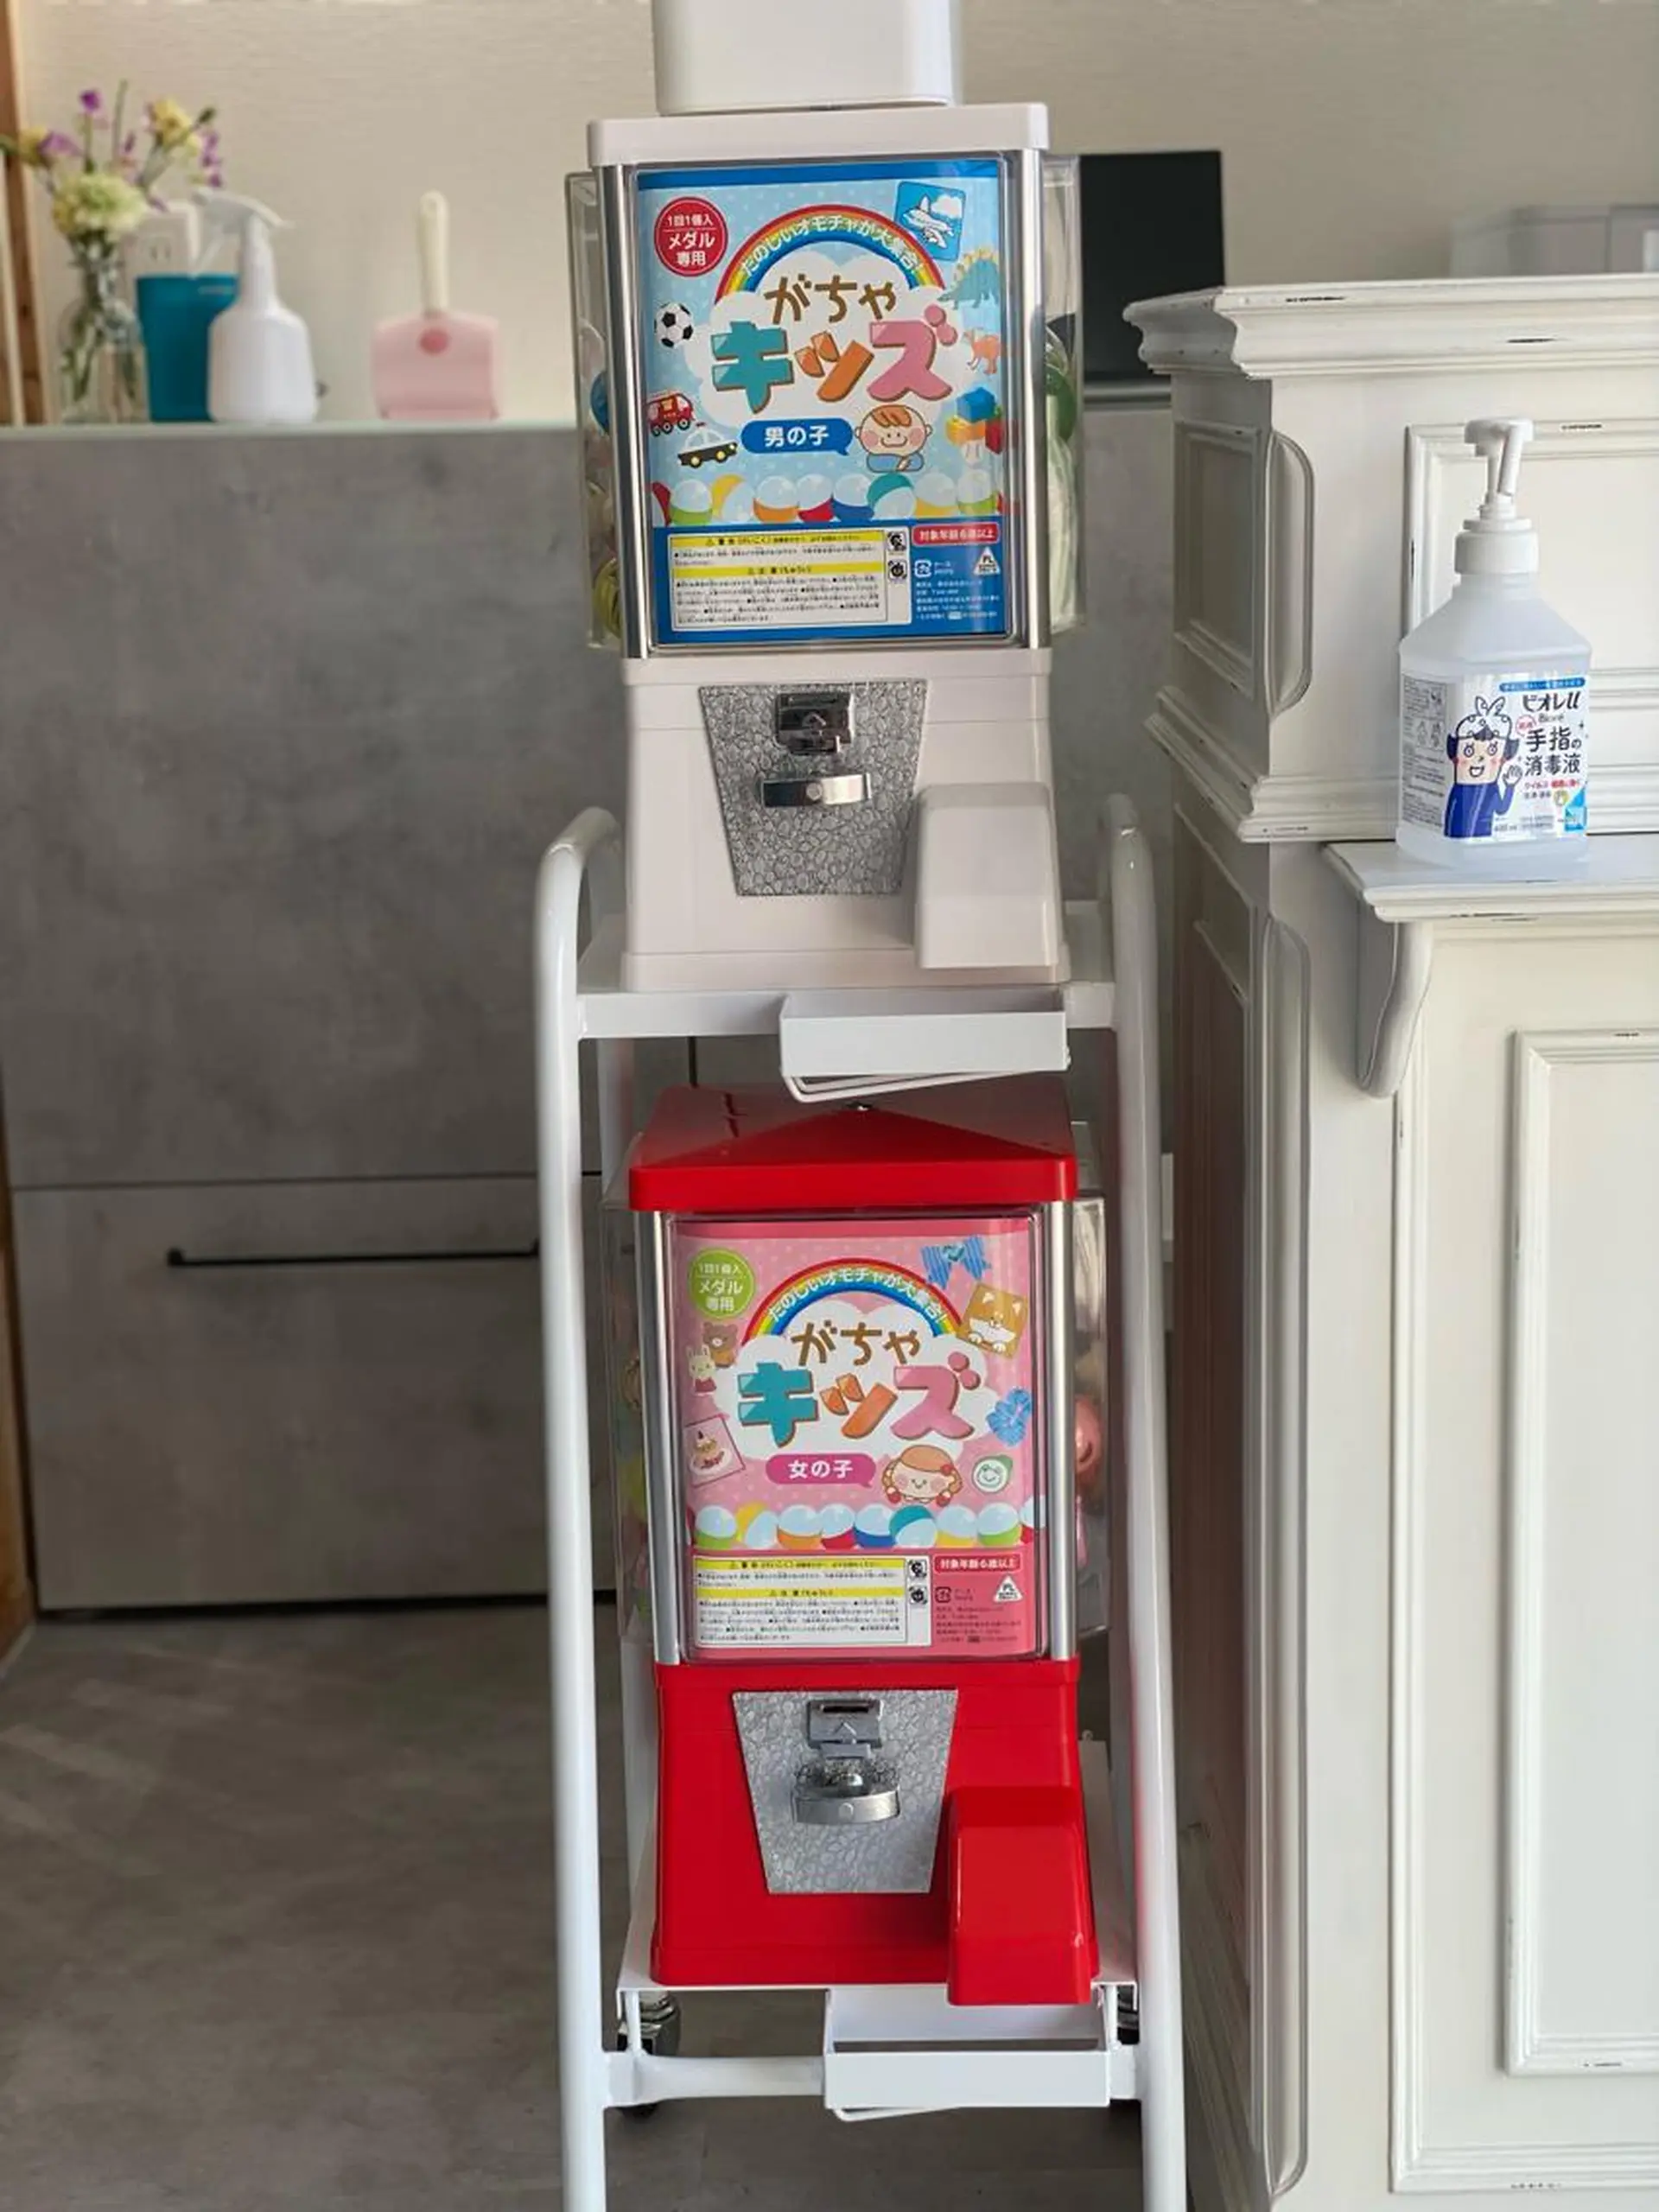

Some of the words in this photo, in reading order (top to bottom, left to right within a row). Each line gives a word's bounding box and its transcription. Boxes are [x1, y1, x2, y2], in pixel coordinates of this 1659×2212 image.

[668, 229, 715, 250] メダル
[677, 251, 706, 267] 専用
[765, 274, 897, 324] がちゃ
[710, 304, 958, 414] キッズ
[765, 425, 830, 448] 男の子
[1525, 726, 1582, 752] 手指の
[1524, 753, 1581, 776] 消毒液
[699, 1279, 743, 1295] メダル
[791, 1319, 921, 1366] がちゃ
[736, 1351, 981, 1448] キッズ
[788, 1459, 854, 1479] 女の子
